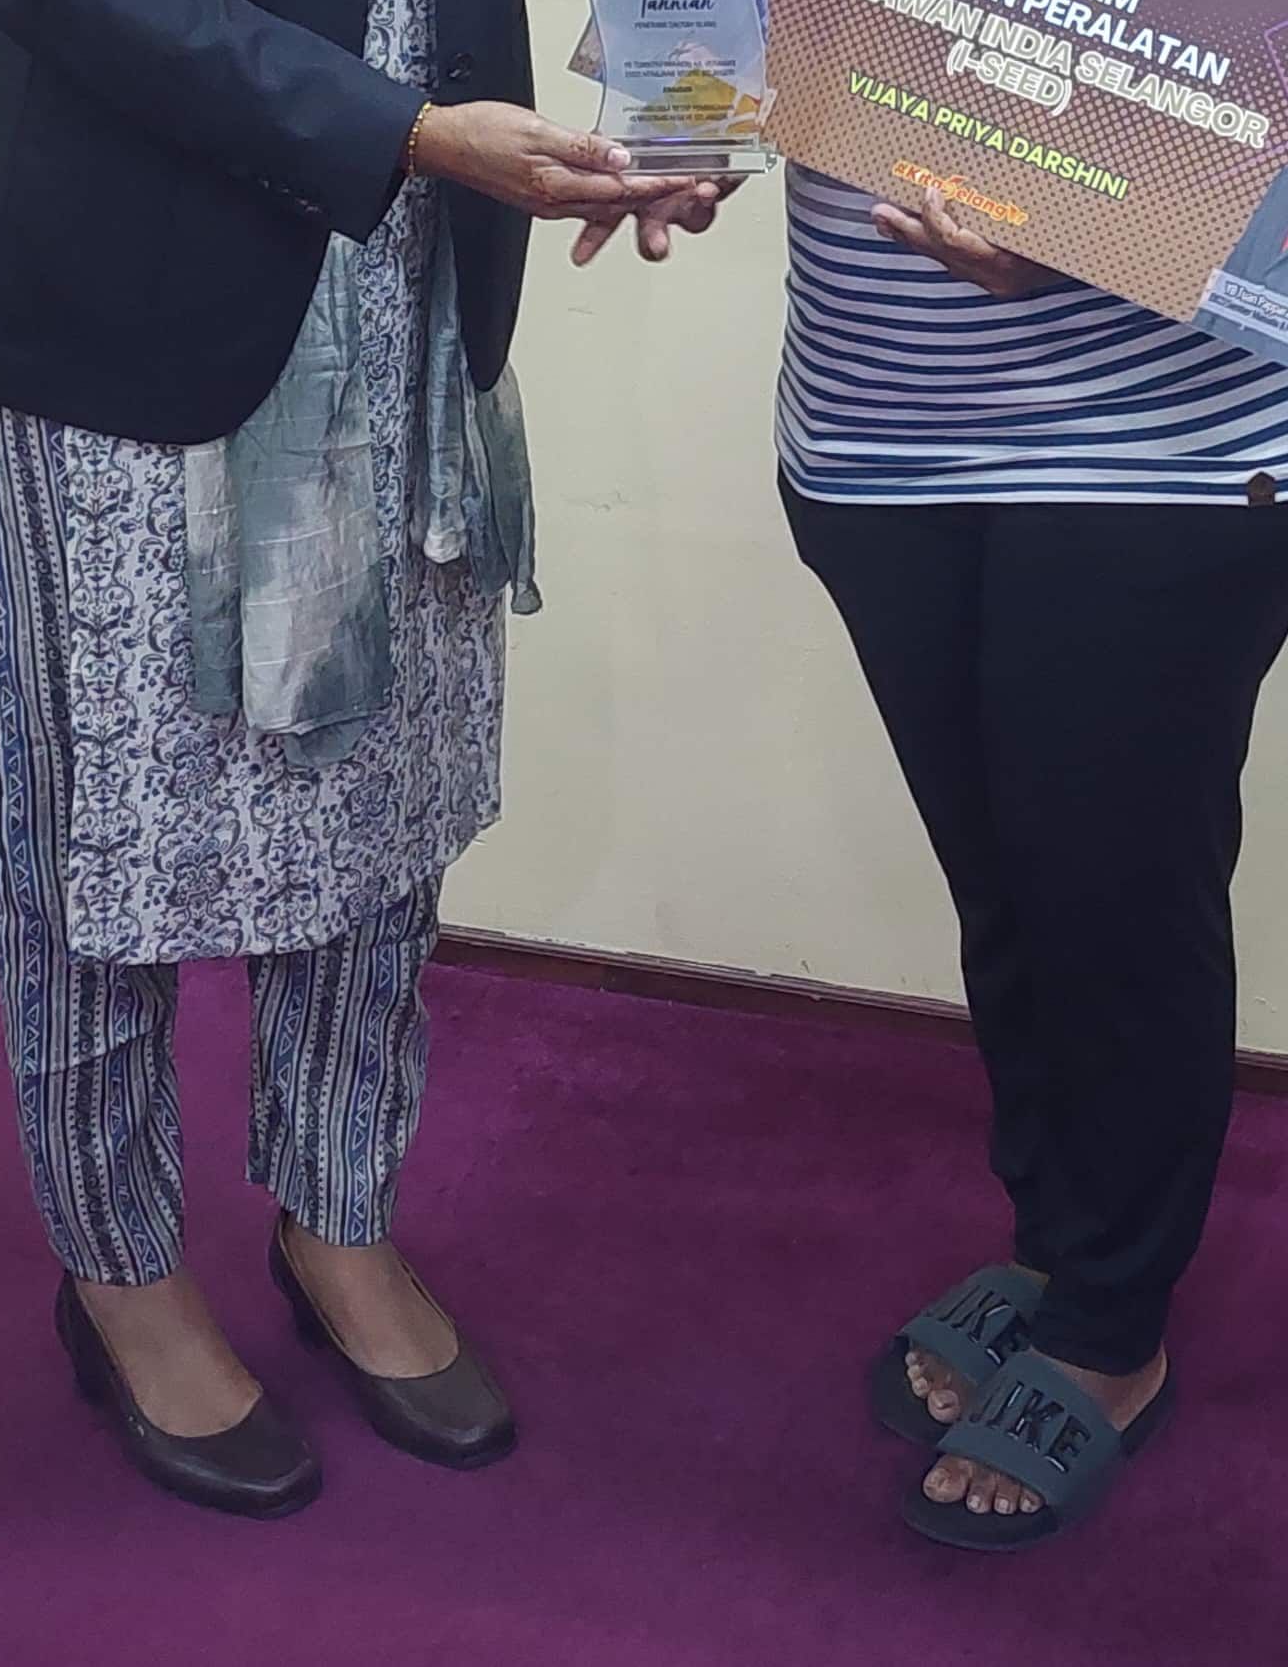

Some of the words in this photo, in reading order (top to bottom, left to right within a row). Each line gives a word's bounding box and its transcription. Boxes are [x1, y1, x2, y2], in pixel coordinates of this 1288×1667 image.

[849, 71, 929, 122] VIJAYA
[934, 107, 1005, 152] PRIYA
[1009, 137, 1130, 201] DARSHINI
[947, 39, 1072, 117] (I-SEED)
[979, 13, 1072, 76] INDIA
[1075, 51, 1269, 148] SELANGOR
